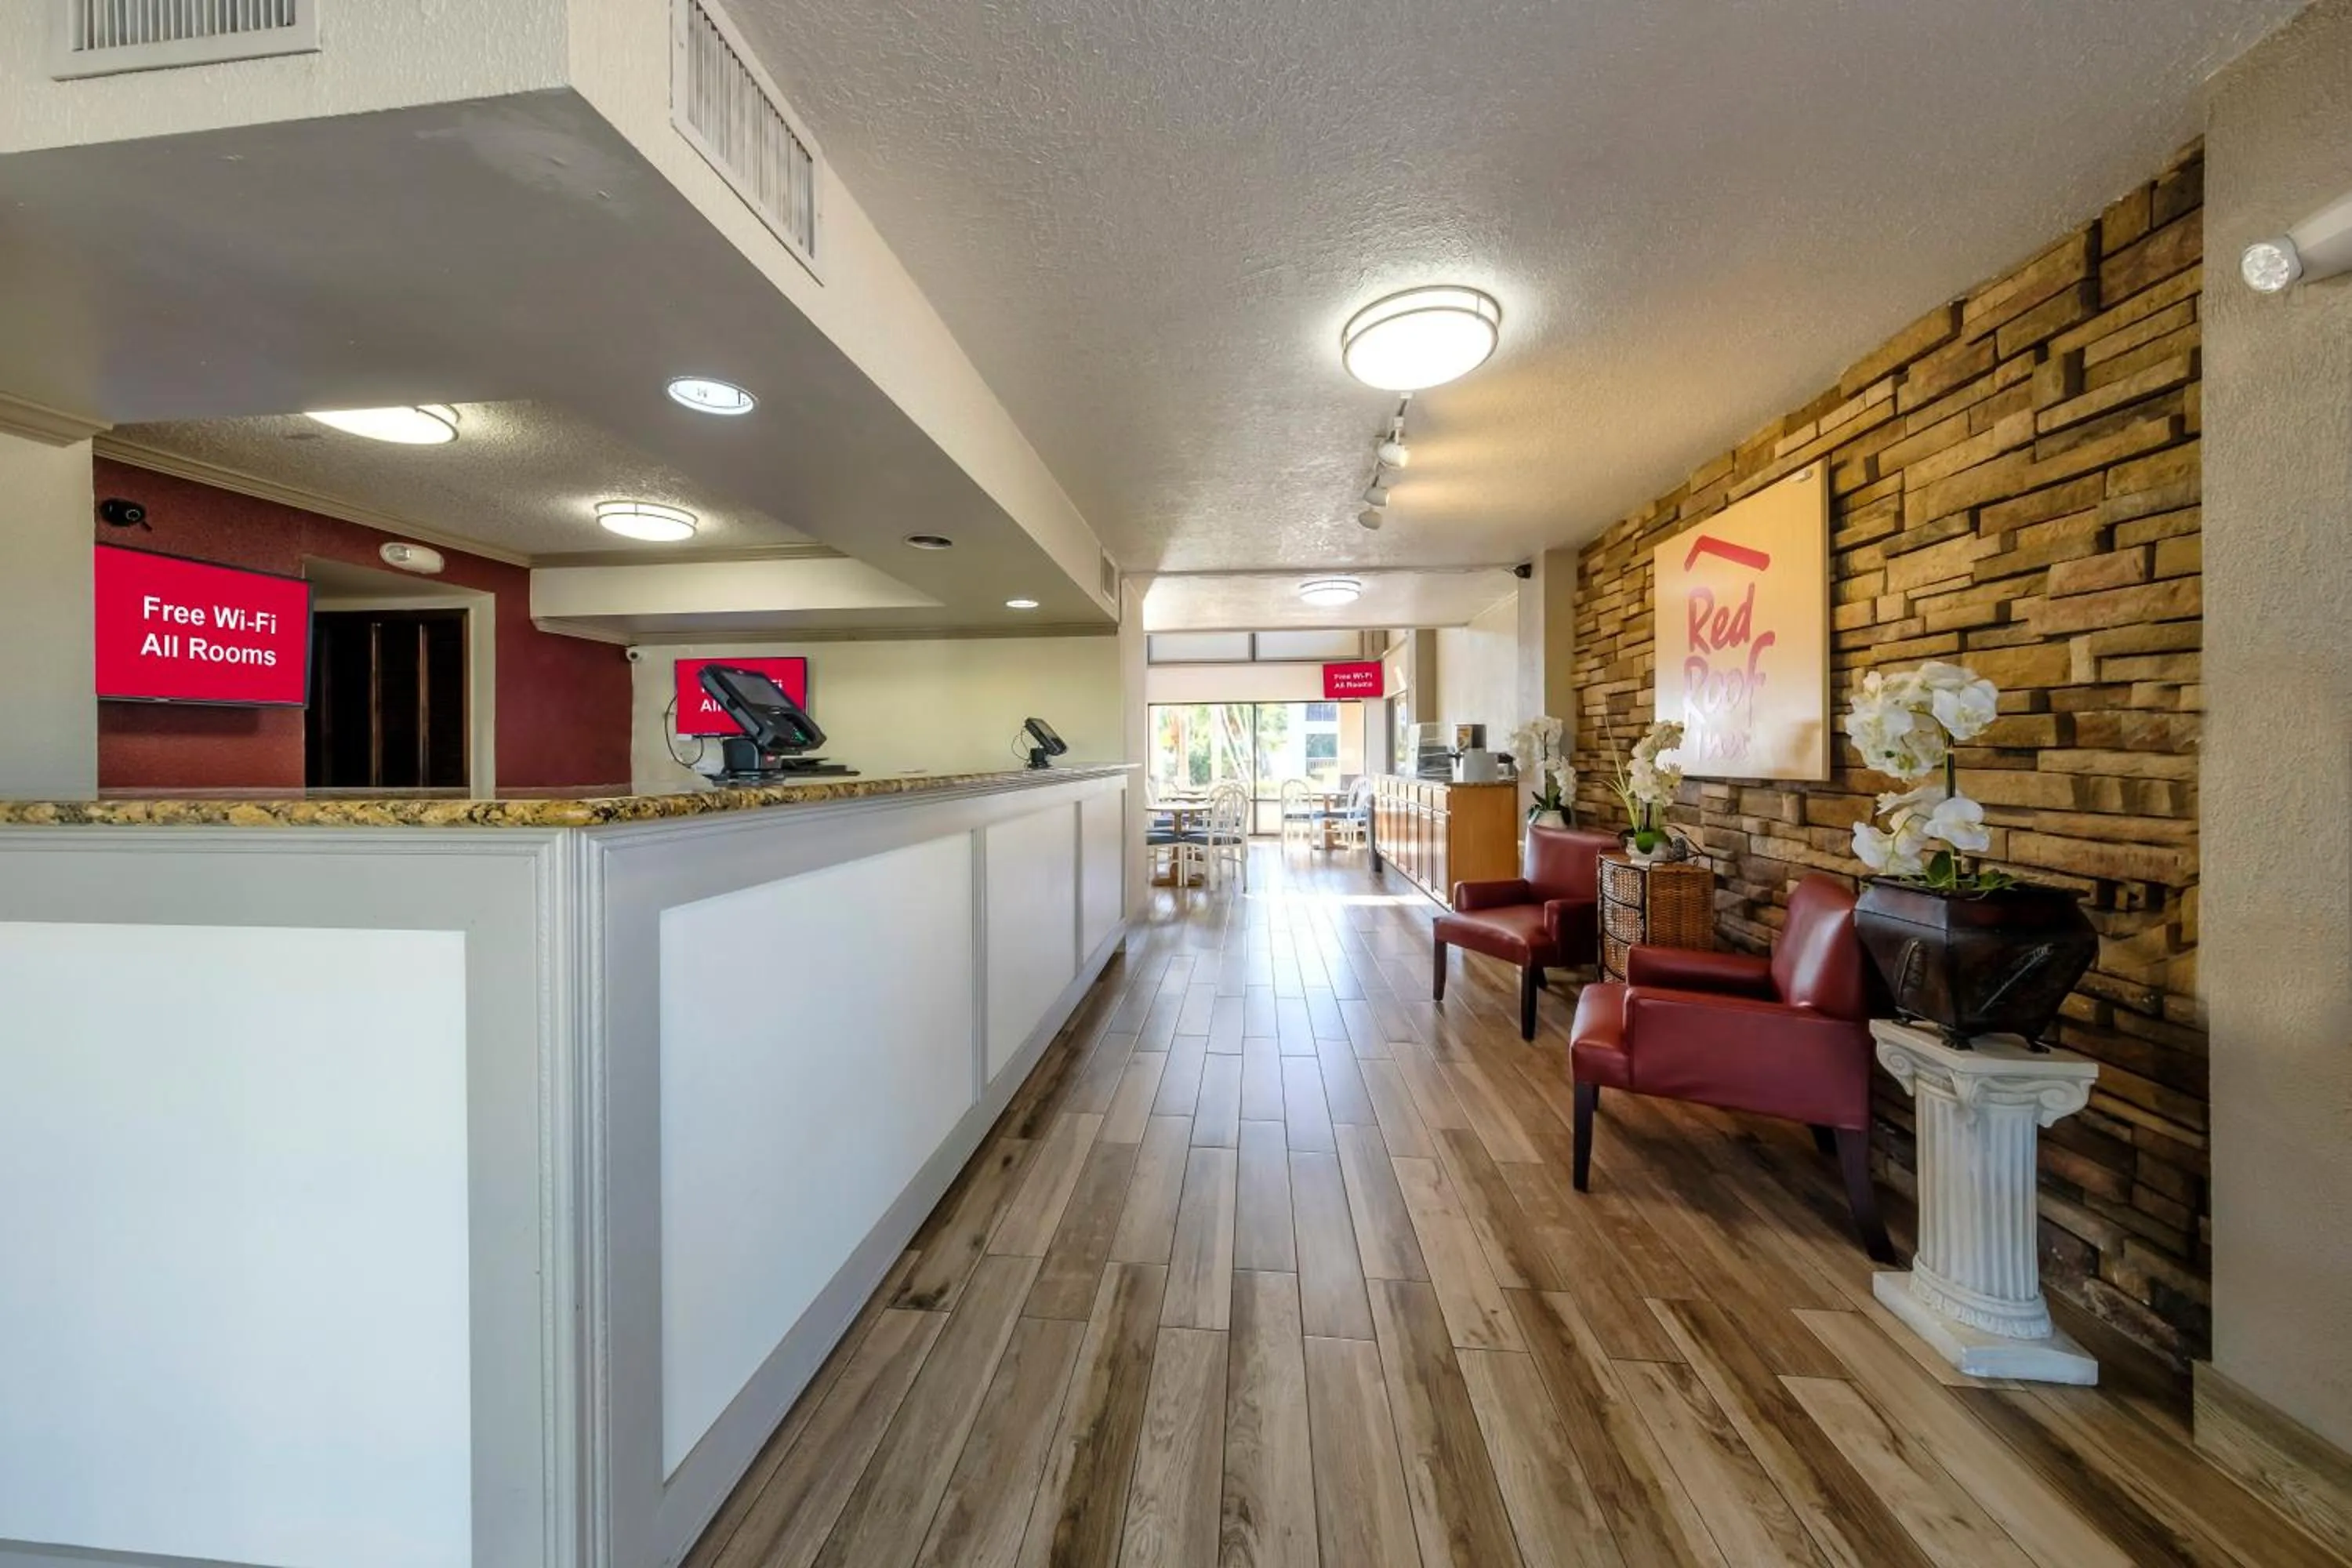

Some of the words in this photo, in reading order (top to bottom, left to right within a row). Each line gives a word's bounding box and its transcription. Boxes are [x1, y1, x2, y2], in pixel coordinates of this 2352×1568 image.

[143, 595, 205, 626] Free
[213, 605, 276, 634] Wi-Fi
[1688, 582, 1755, 655] Red
[140, 633, 179, 658] All
[188, 637, 277, 666] Rooms
[1683, 630, 1775, 729] Roof
